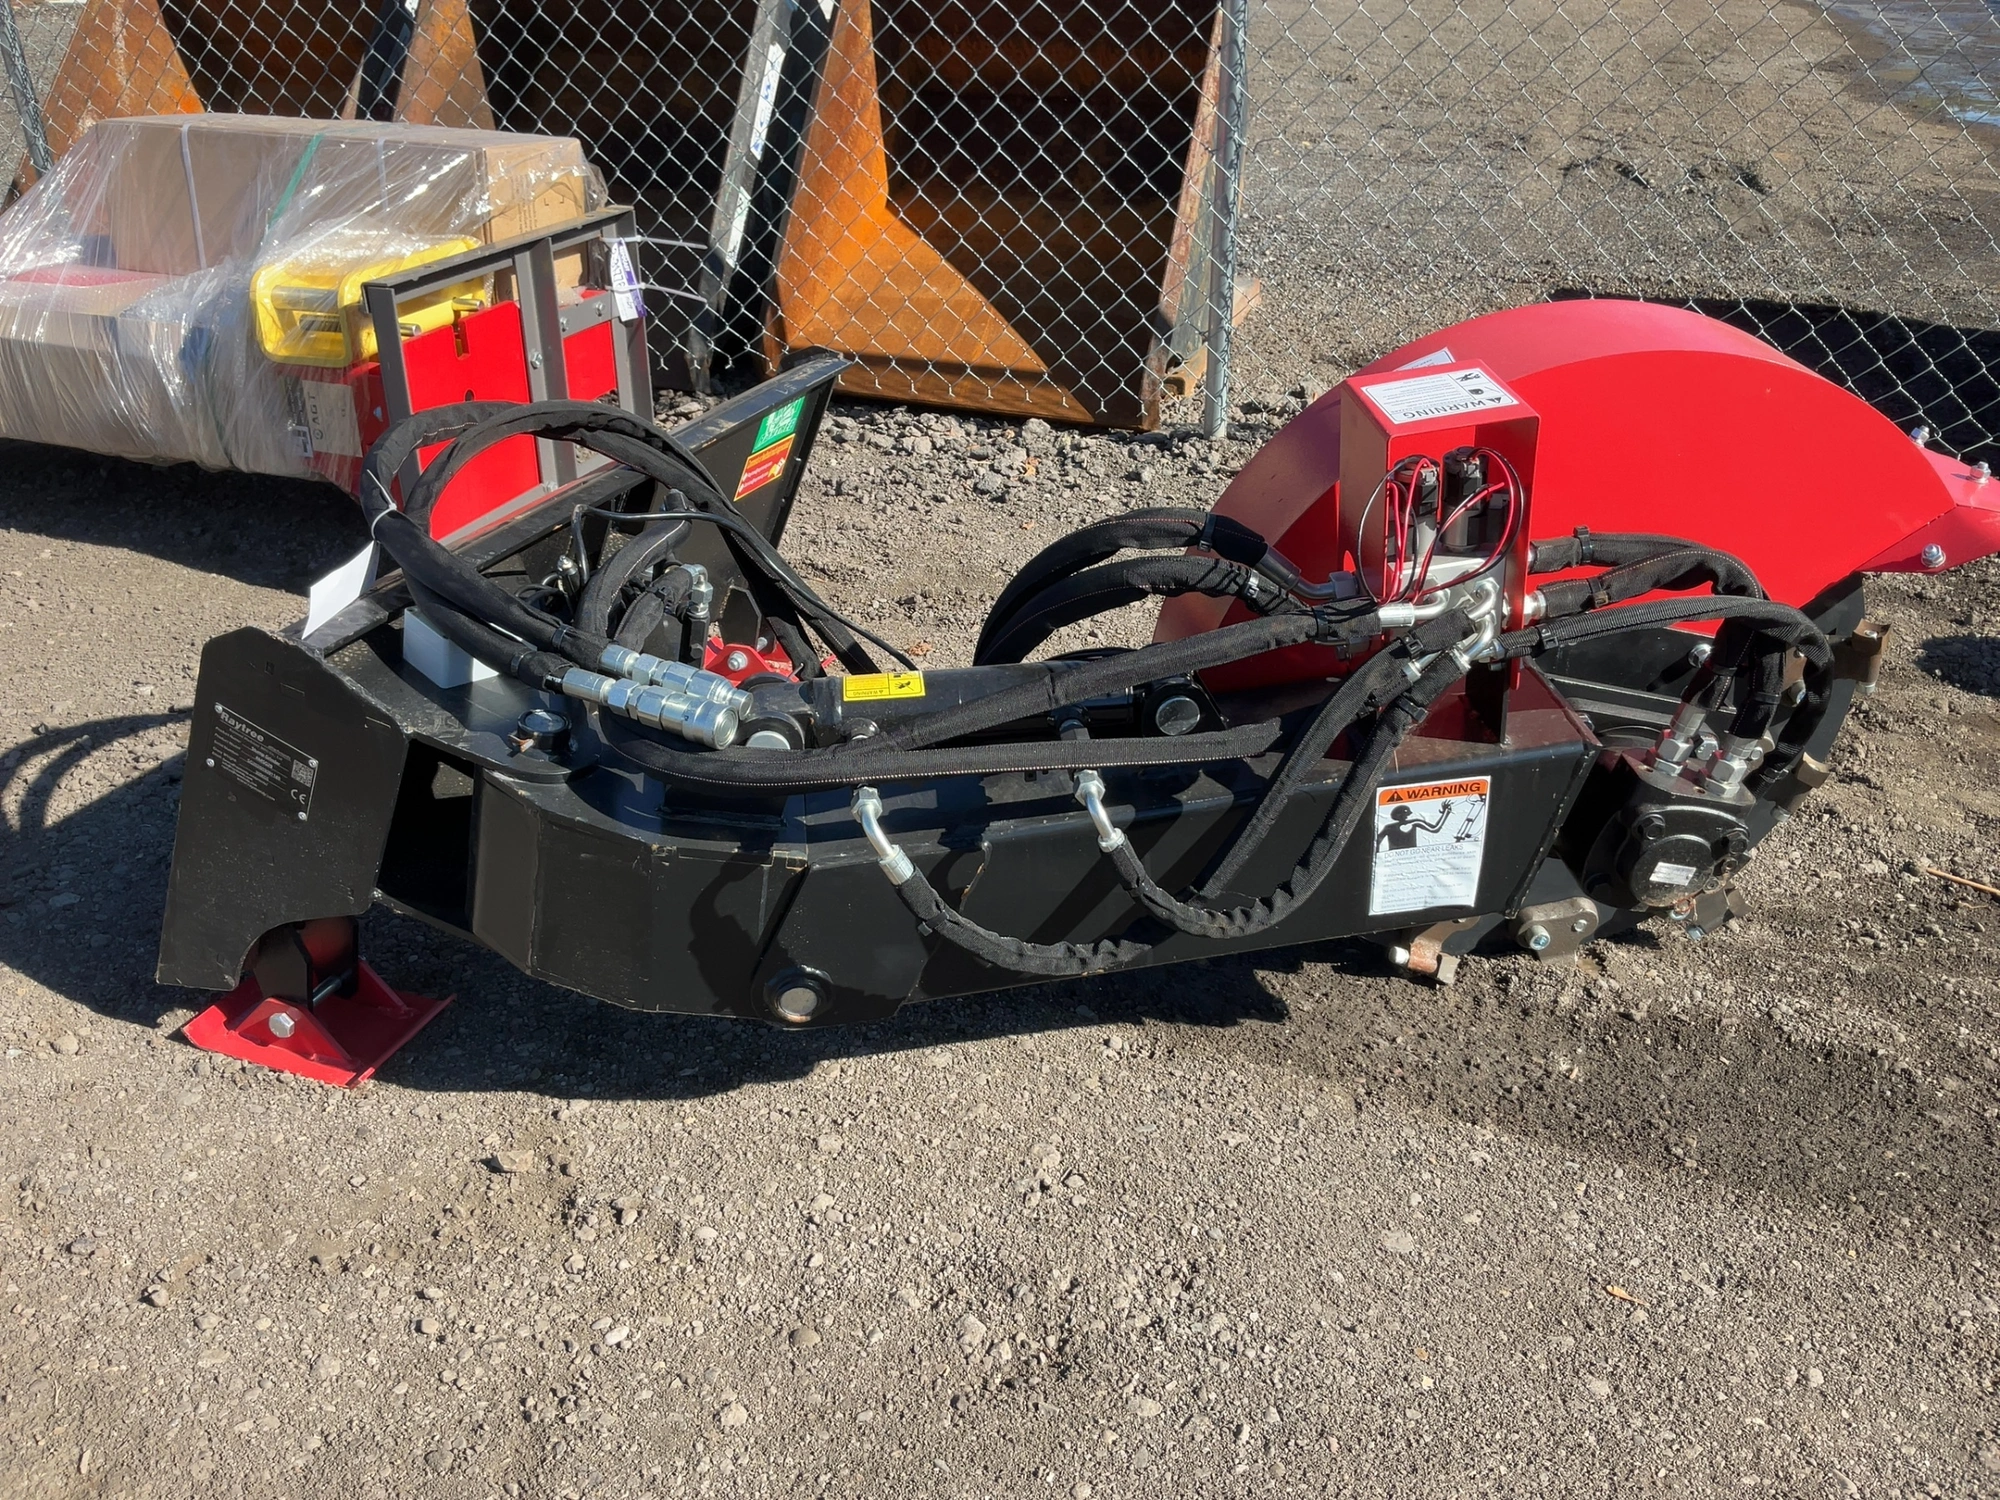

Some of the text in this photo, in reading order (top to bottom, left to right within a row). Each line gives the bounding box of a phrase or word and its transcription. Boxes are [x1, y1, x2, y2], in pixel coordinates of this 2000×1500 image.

[308, 391, 321, 426] AGT
[1403, 400, 1486, 419] WARNING
[220, 712, 265, 743] Raytree
[290, 788, 307, 805] CE
[1406, 782, 1481, 800] WARNING
[1394, 849, 1409, 857] NOT
[1421, 846, 1440, 854] NEAR
[1441, 843, 1464, 852] LEAKS
